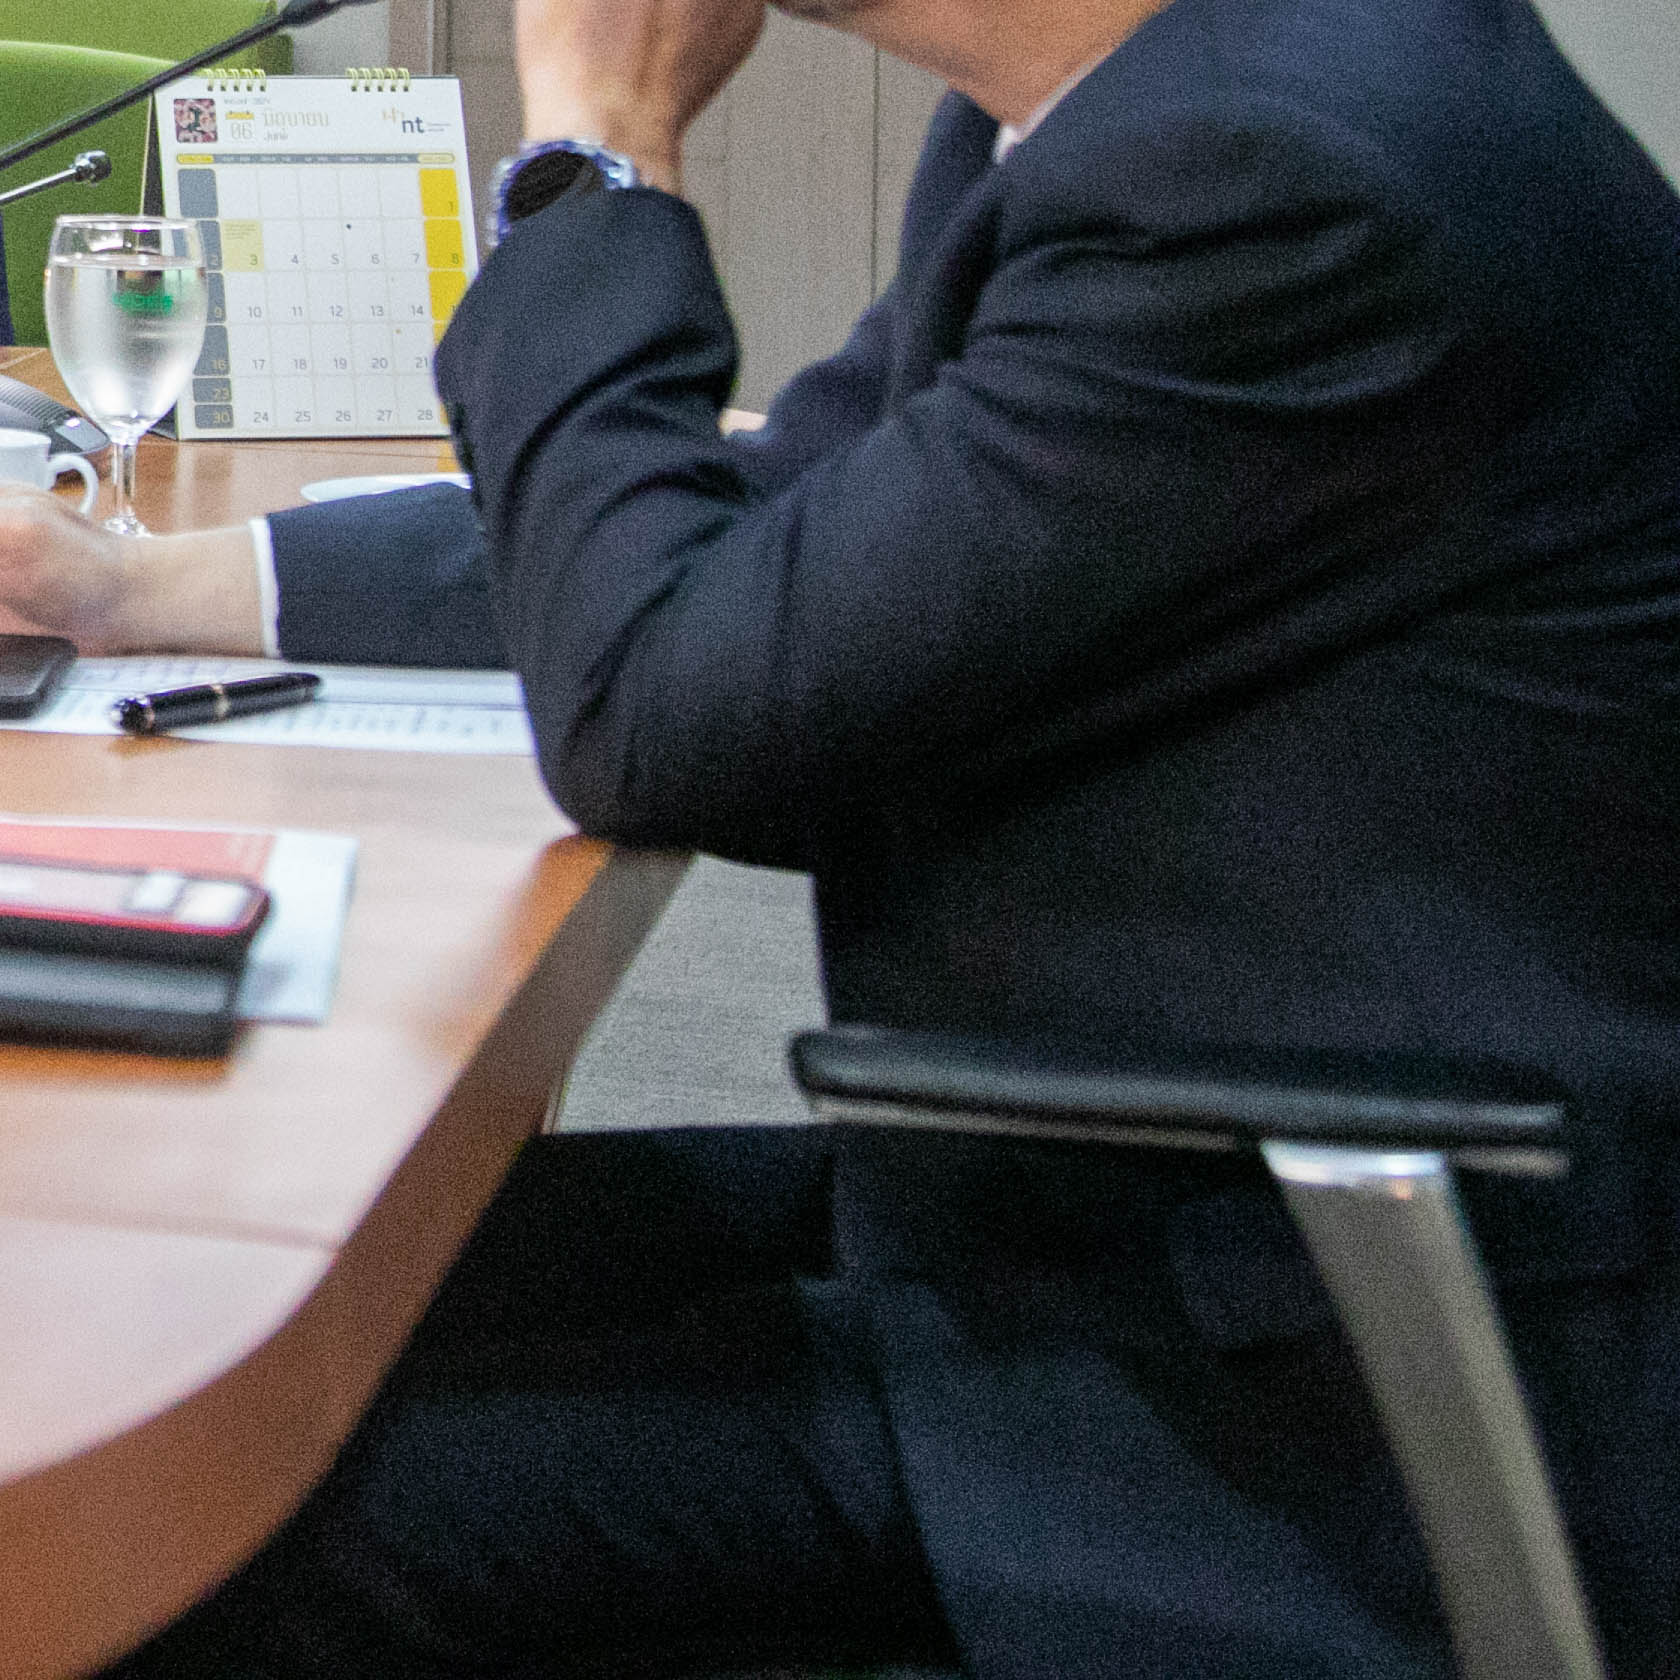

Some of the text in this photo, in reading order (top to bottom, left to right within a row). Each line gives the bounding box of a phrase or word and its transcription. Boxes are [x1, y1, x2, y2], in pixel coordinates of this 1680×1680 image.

[402, 116, 425, 134] nt
[249, 254, 258, 266] 3
[290, 254, 299, 265] 4
[371, 254, 380, 265] 6
[412, 254, 420, 265] 7
[452, 253, 460, 265] 8
[248, 306, 262, 318] 10
[292, 306, 304, 318] 11
[330, 306, 344, 318] 12
[370, 305, 384, 317] 13
[411, 305, 424, 317] 14
[252, 359, 266, 370] 17
[294, 358, 308, 370] 18
[333, 357, 348, 370] 19
[371, 357, 388, 369] 20
[415, 357, 429, 369] 21
[253, 411, 269, 423] 24
[295, 410, 312, 422] 25
[335, 410, 352, 422] 26
[376, 409, 392, 421] 27
[416, 409, 434, 421] 28
